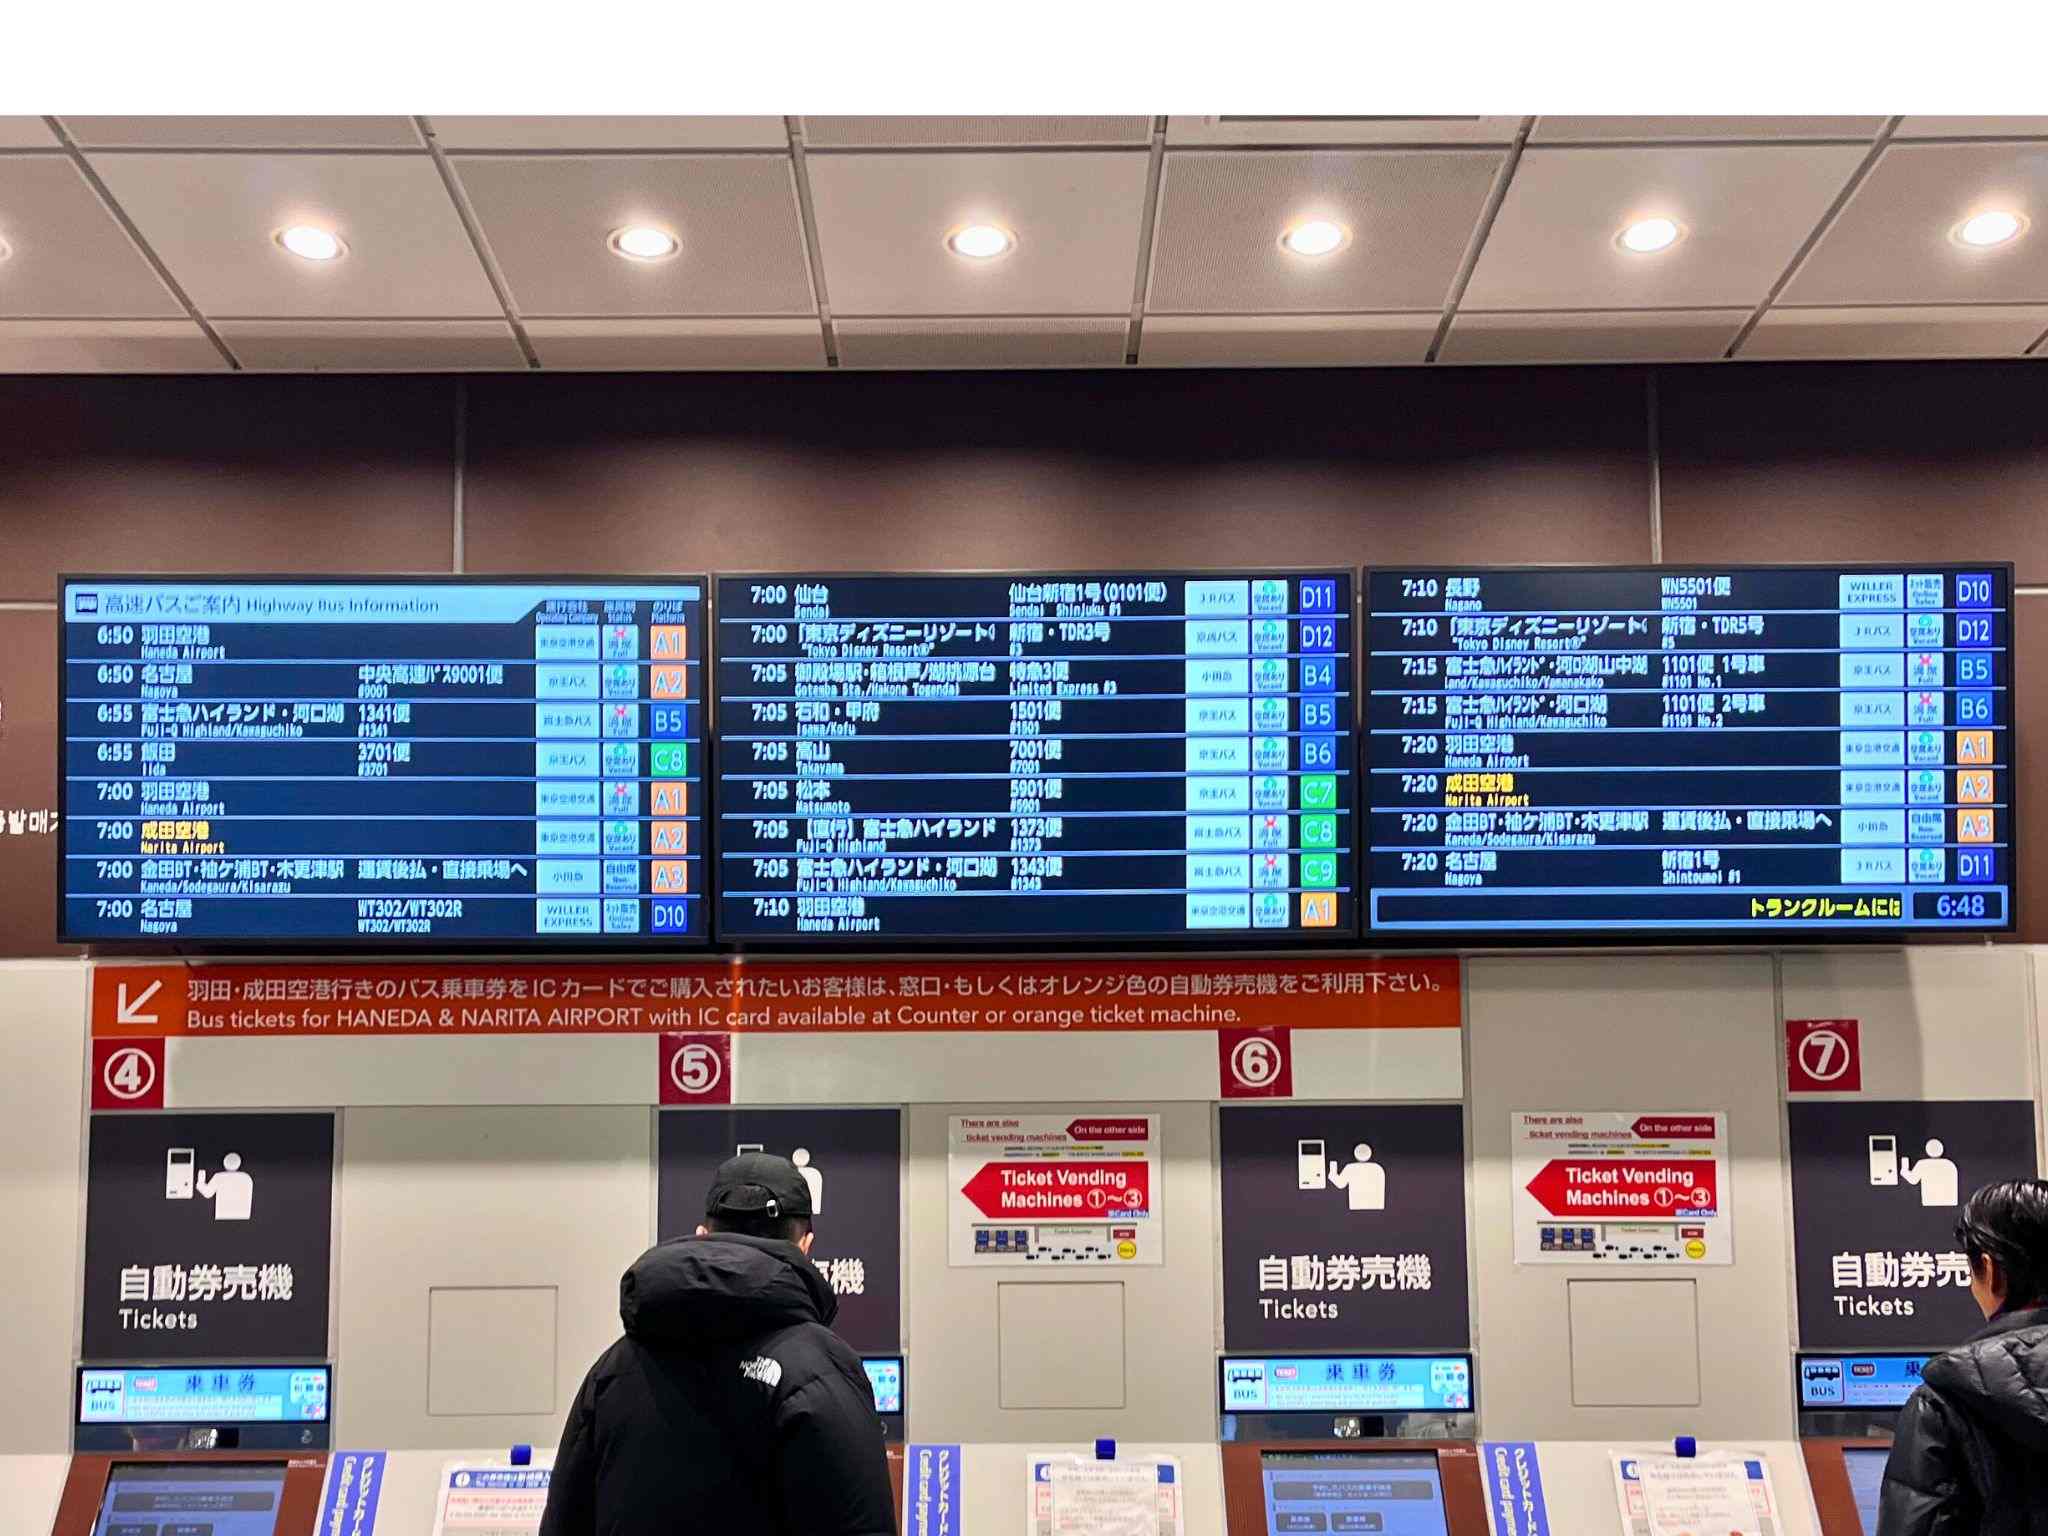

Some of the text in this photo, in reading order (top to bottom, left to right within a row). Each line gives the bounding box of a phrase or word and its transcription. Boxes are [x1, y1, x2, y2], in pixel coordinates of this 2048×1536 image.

[751, 585, 786, 604] 7:00
[794, 584, 829, 604] 仙台
[1302, 586, 1332, 608] D11
[1402, 578, 1438, 597] 7:10
[1959, 581, 1989, 602] D10
[106, 594, 439, 616] 高速バスご案内 Highway Bus Information
[97, 625, 133, 645] 6:50
[654, 631, 680, 654] A1
[751, 624, 787, 643] 7:00
[1302, 625, 1332, 647] D12
[1402, 618, 1438, 636] 7:10
[1959, 620, 1989, 641] D12
[97, 665, 133, 684] 6:50
[141, 664, 193, 684] 名古屋
[654, 669, 682, 693] A2
[751, 664, 1331, 685] 7:05 B4
[1402, 657, 1437, 675] 7:15
[1961, 659, 1988, 680] B5
[97, 704, 133, 723] 6:55
[655, 711, 682, 732] B5
[752, 703, 788, 721] 7:05
[1304, 704, 1331, 724] B5
[1402, 696, 1437, 714] 7:15
[1961, 698, 1988, 719] B6
[97, 743, 133, 762] 6:55
[654, 750, 684, 771] C8
[752, 742, 788, 761] 7:05
[1304, 743, 1331, 764] B6
[1401, 735, 1438, 754] 7:20
[1960, 736, 1986, 758] A1
[97, 782, 133, 800] 7:00
[141, 781, 210, 801] 羽田空港
[654, 788, 681, 810] A1
[753, 781, 789, 799] 7:05
[1304, 782, 1332, 803] C7
[1401, 774, 1437, 793] 7:20
[1446, 773, 1513, 793] 成田空港
[1961, 777, 1989, 798] A2
[97, 821, 133, 839] 7:00
[141, 821, 209, 840] 成田空港
[654, 828, 683, 849] A2
[753, 820, 789, 839] 7:05
[1304, 821, 1333, 842] C8
[1401, 813, 1437, 832] 7:20
[1961, 815, 1990, 837] A3
[97, 860, 133, 879] 7:00
[655, 867, 683, 888] A3
[753, 859, 789, 878] 7:05
[1304, 860, 1333, 881] C9
[1401, 853, 1438, 871] 7:20
[1446, 851, 1497, 871] 名古屋
[1960, 855, 1990, 876] D11
[97, 900, 133, 918] 7:00
[141, 899, 192, 918] 名古屋
[358, 900, 462, 918] WT302/WT302R
[654, 905, 685, 927] D10
[753, 898, 790, 917] 7:10
[1304, 900, 1331, 921] A1
[1937, 895, 1985, 916] 6:48
[188, 1005, 1241, 1029] Bus tickets for HANEDA & NARITA AIRPORT with IC card available at Counter or orange ticket machine.
[1001, 1169, 1127, 1188] Ticket Vending
[1565, 1167, 1694, 1187] Ticket Vending
[1001, 1191, 1083, 1208] Machines
[1566, 1189, 1650, 1206] Machines
[1259, 1254, 1432, 1291] 自動券売機
[1832, 1251, 1972, 1288] 自動券売
[120, 1263, 293, 1301] 自動券売機
[1259, 1298, 1338, 1319] Tickets
[1833, 1295, 1915, 1316] Tickets
[119, 1307, 198, 1329] Tickets
[1811, 1386, 1835, 1396] BUS
